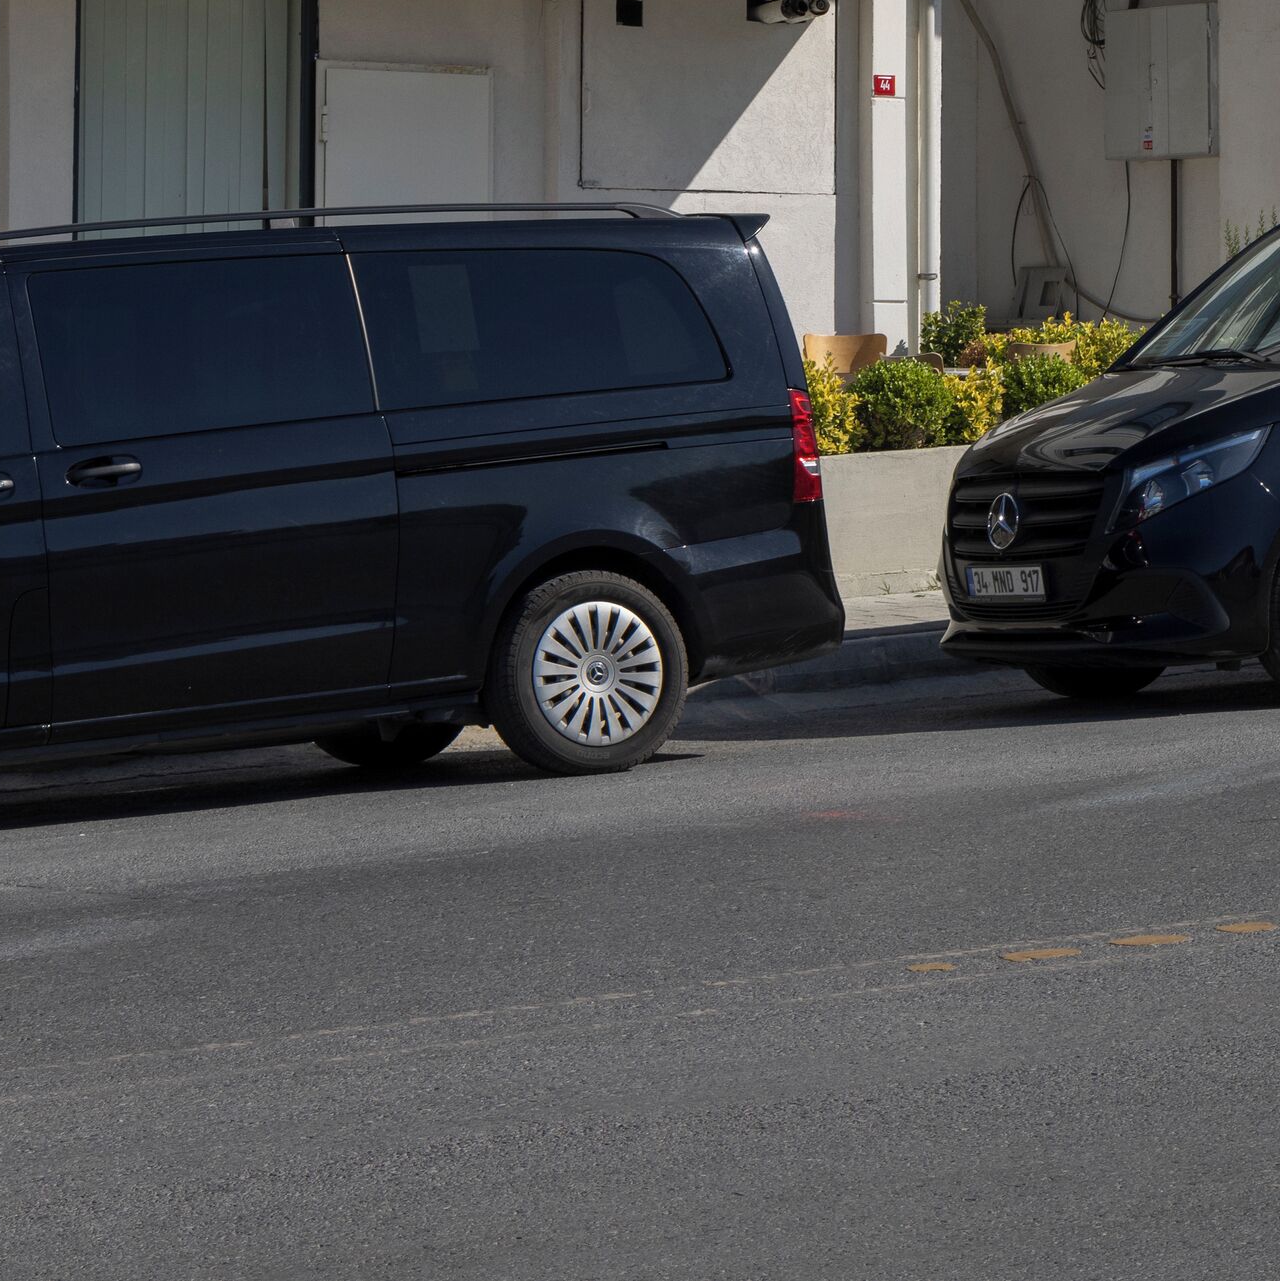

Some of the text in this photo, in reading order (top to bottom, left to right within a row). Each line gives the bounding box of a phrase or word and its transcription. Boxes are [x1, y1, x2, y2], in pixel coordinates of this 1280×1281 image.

[880, 80, 890, 90] 44
[974, 571, 988, 593] 34
[1020, 570, 1039, 593] 917
